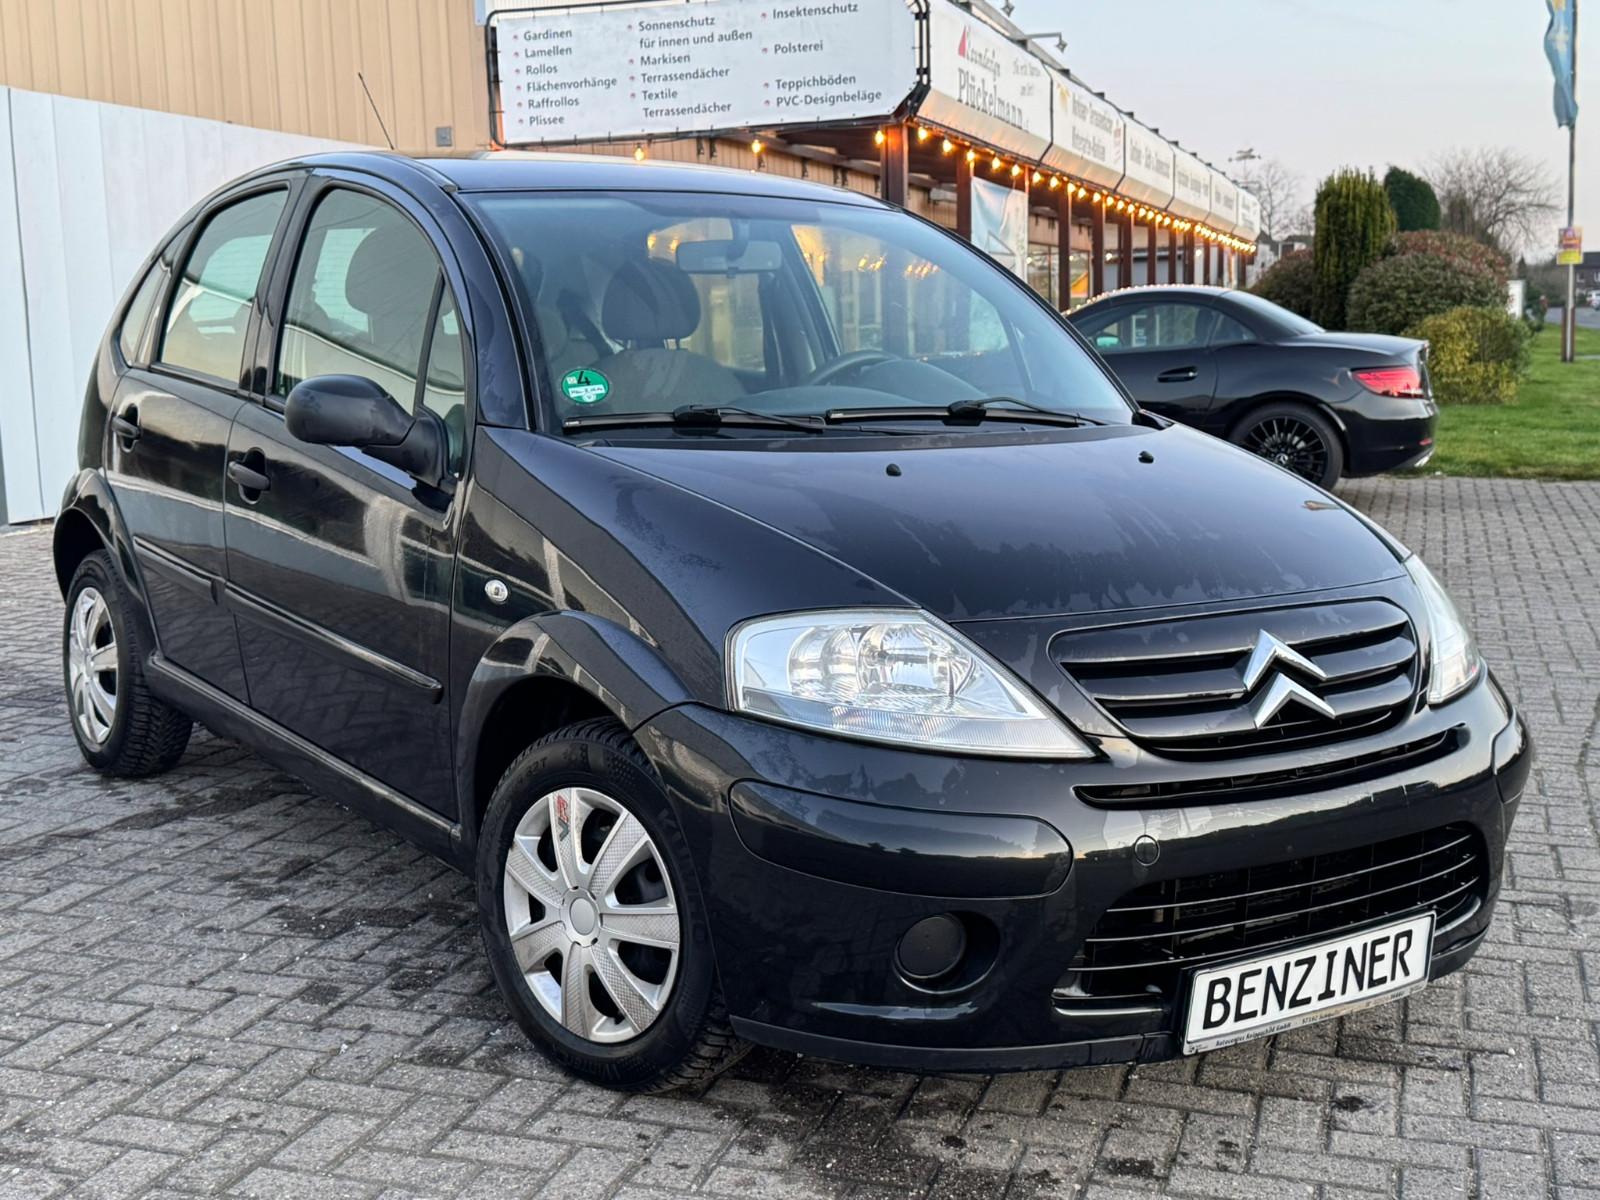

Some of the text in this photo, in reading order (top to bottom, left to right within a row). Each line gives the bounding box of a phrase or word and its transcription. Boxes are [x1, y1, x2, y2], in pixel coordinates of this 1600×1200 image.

[773, 3, 859, 19] Insektenschutz
[638, 16, 716, 32] Sonnenschutz
[523, 29, 573, 41] Gardinen
[640, 30, 753, 49] für innen und außen
[524, 45, 573, 58] Lamellen
[774, 40, 824, 54] Polsterei
[640, 53, 691, 66] Markisen
[526, 64, 558, 75] Rollos
[641, 67, 730, 84] Terrassendächer
[526, 77, 618, 92] Flächenvorhänge
[775, 74, 857, 92] Teppichböden
[642, 88, 679, 101] Textile
[776, 90, 882, 108] PVC-Designbeläge
[527, 96, 580, 109] Raffrollos
[643, 102, 732, 119] Terrassendächer
[529, 115, 565, 126] Plissee
[577, 370, 591, 385] 4
[1202, 929, 1413, 1030] BENZINER
